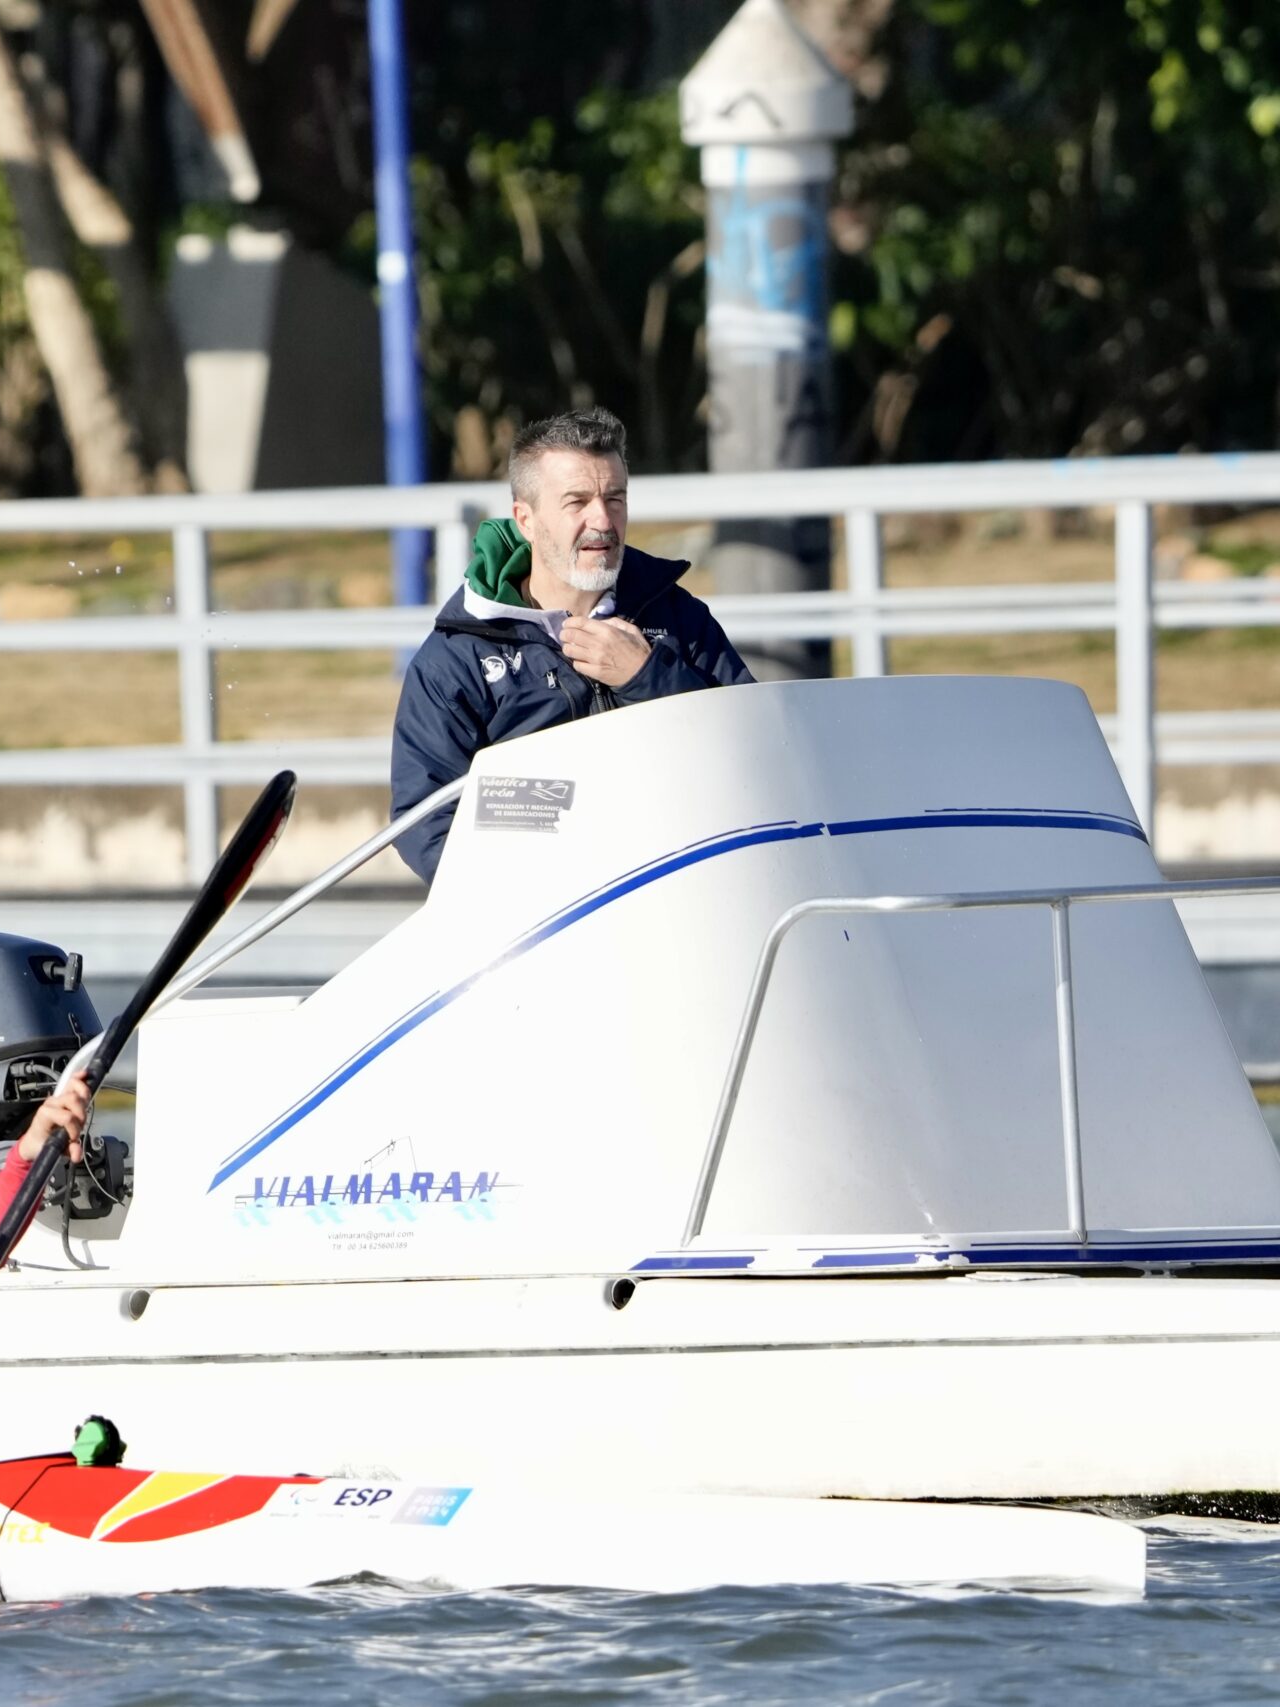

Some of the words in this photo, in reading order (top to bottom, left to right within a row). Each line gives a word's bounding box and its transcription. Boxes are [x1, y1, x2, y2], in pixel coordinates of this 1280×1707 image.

[480, 776, 528, 788] Náutica
[482, 788, 516, 798] León
[253, 1172, 501, 1208] VIALMARAN
[333, 1487, 394, 1507] ESP
